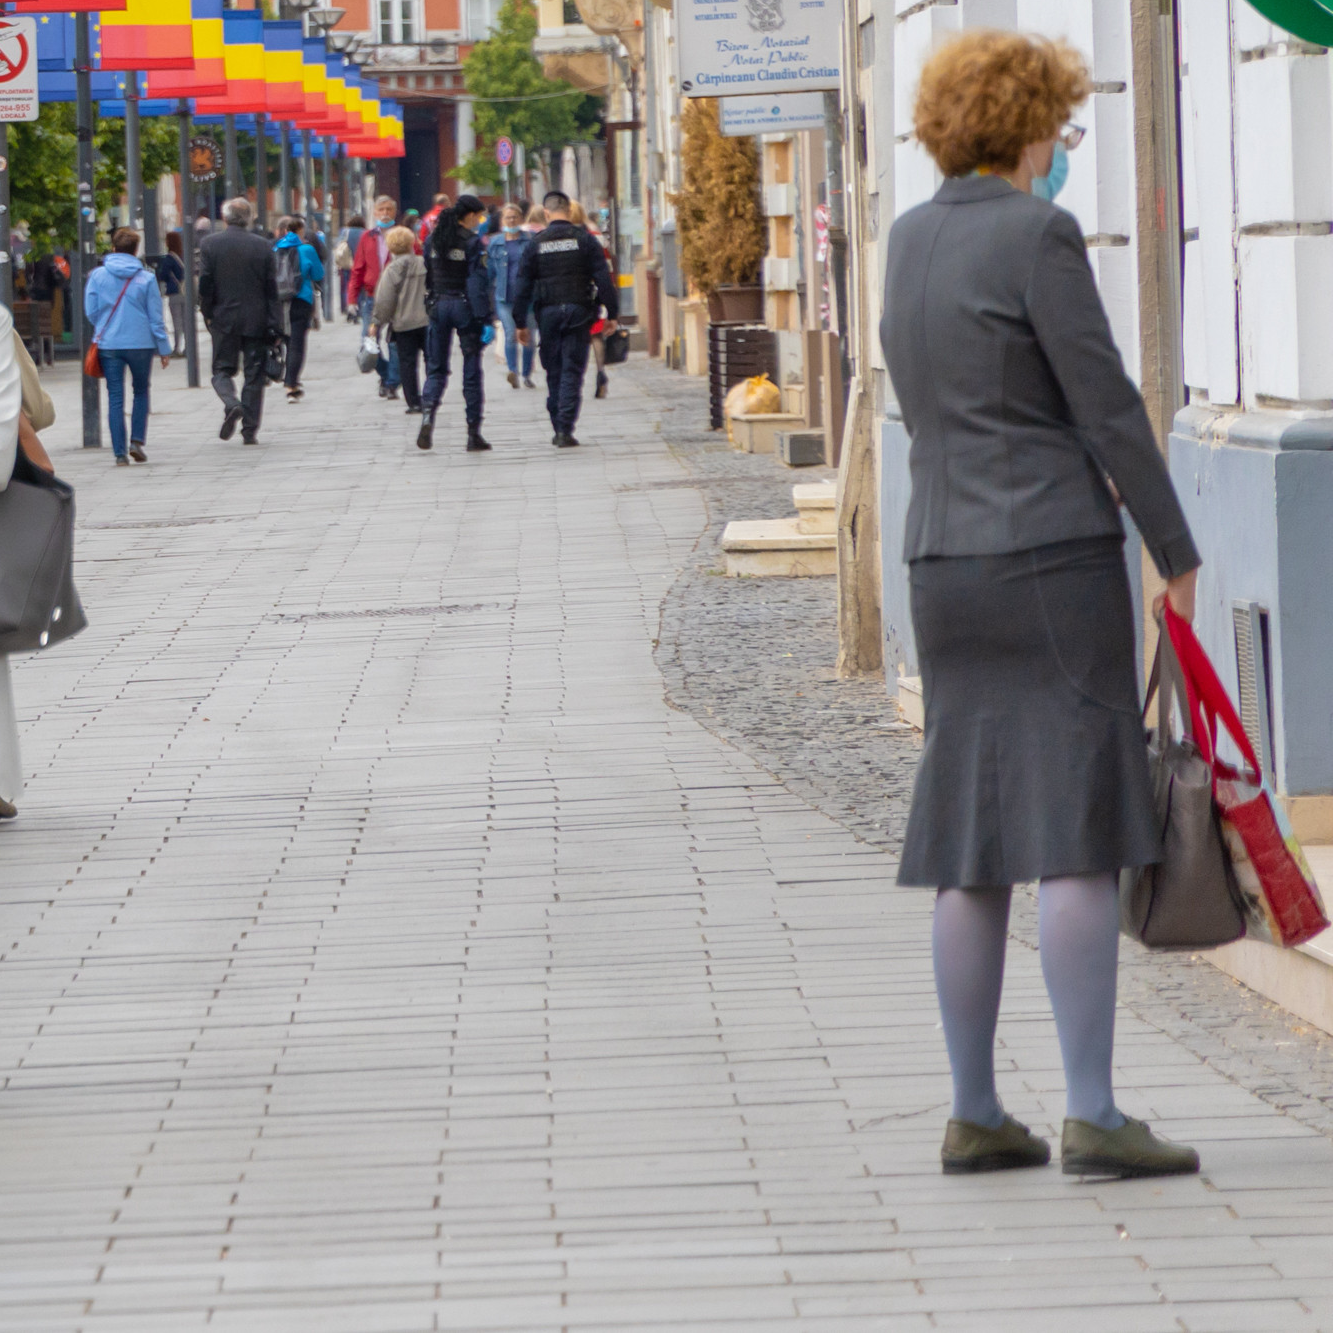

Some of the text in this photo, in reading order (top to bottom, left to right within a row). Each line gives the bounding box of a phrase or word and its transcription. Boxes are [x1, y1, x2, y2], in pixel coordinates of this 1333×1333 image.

[753, 35, 810, 51] Notarial
[723, 50, 808, 68] Notar Public
[757, 68, 797, 81] Claudiu
[799, 66, 840, 79] Cristian
